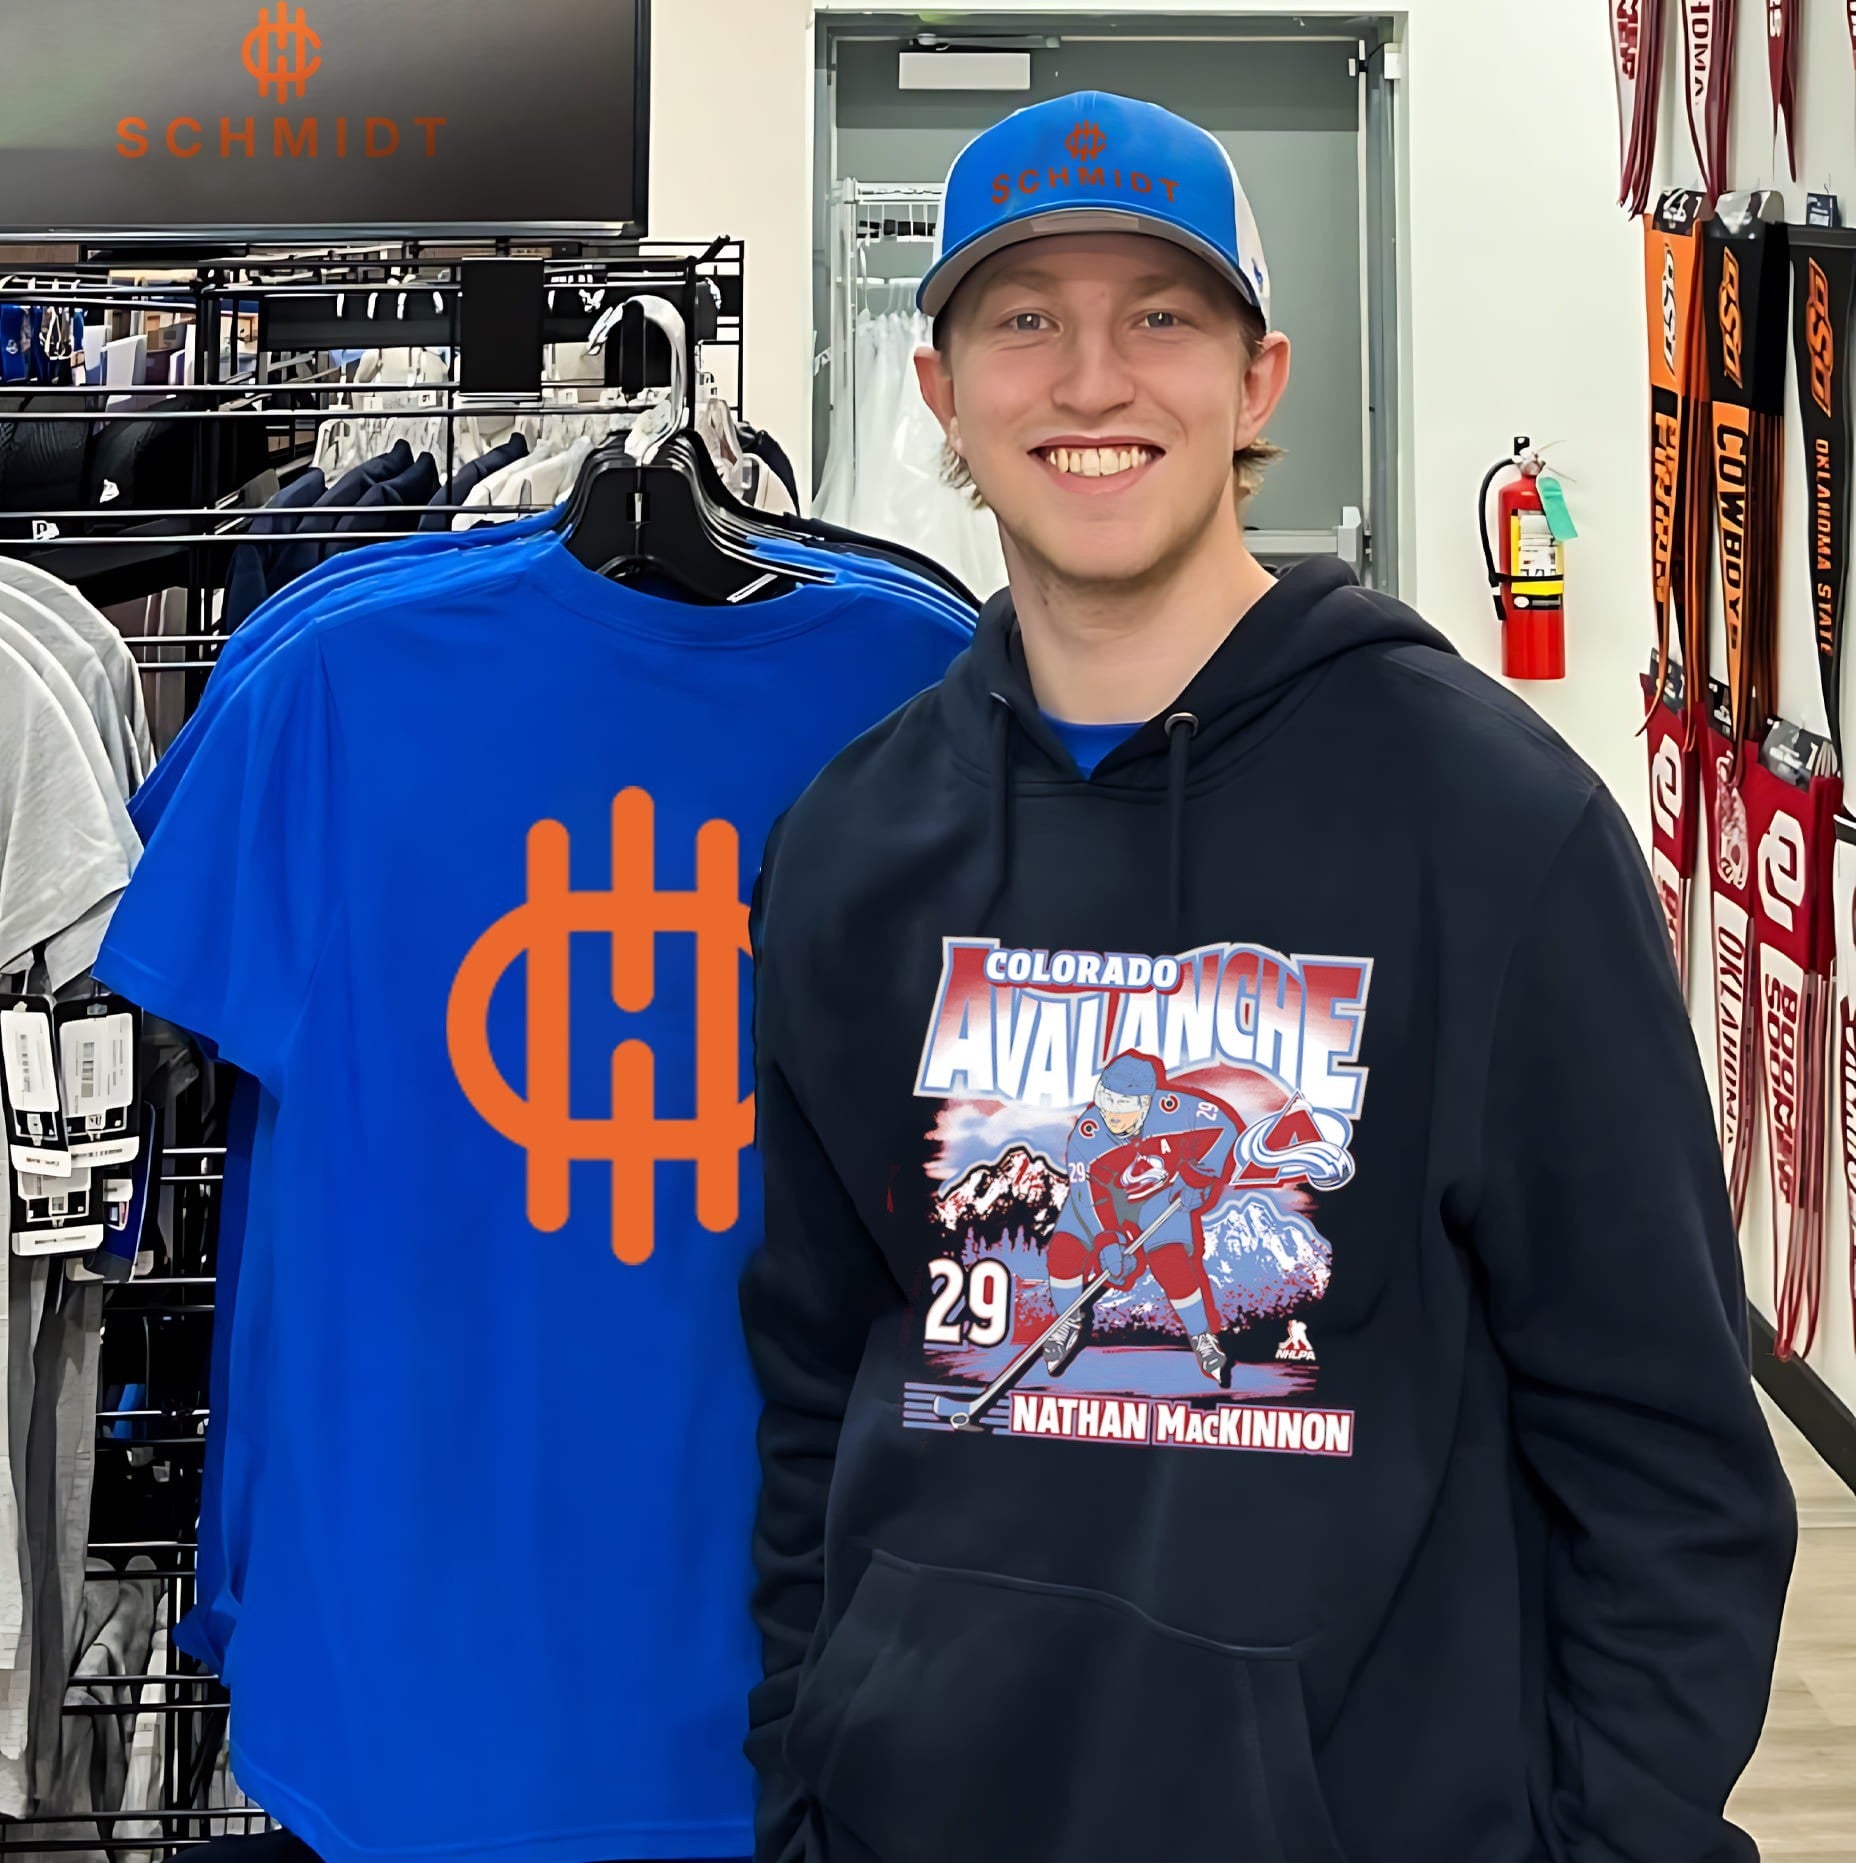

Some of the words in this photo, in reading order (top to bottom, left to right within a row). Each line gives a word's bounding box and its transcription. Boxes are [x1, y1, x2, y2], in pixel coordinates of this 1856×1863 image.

[116, 116, 447, 159] SCHMIDT
[992, 167, 1179, 205] SCHMIDT
[1815, 437, 1832, 570] OKLAHOMA
[987, 950, 1180, 990] COLORADO
[916, 938, 1373, 1117] AVALANCHE
[1718, 925, 1745, 1144] OKLAHOMA
[1195, 1101, 1219, 1122] 29
[1068, 1162, 1086, 1183] 29
[926, 1259, 1010, 1345] 29
[1275, 1349, 1316, 1360] NHLPA
[1012, 1394, 1148, 1440] NATHAN
